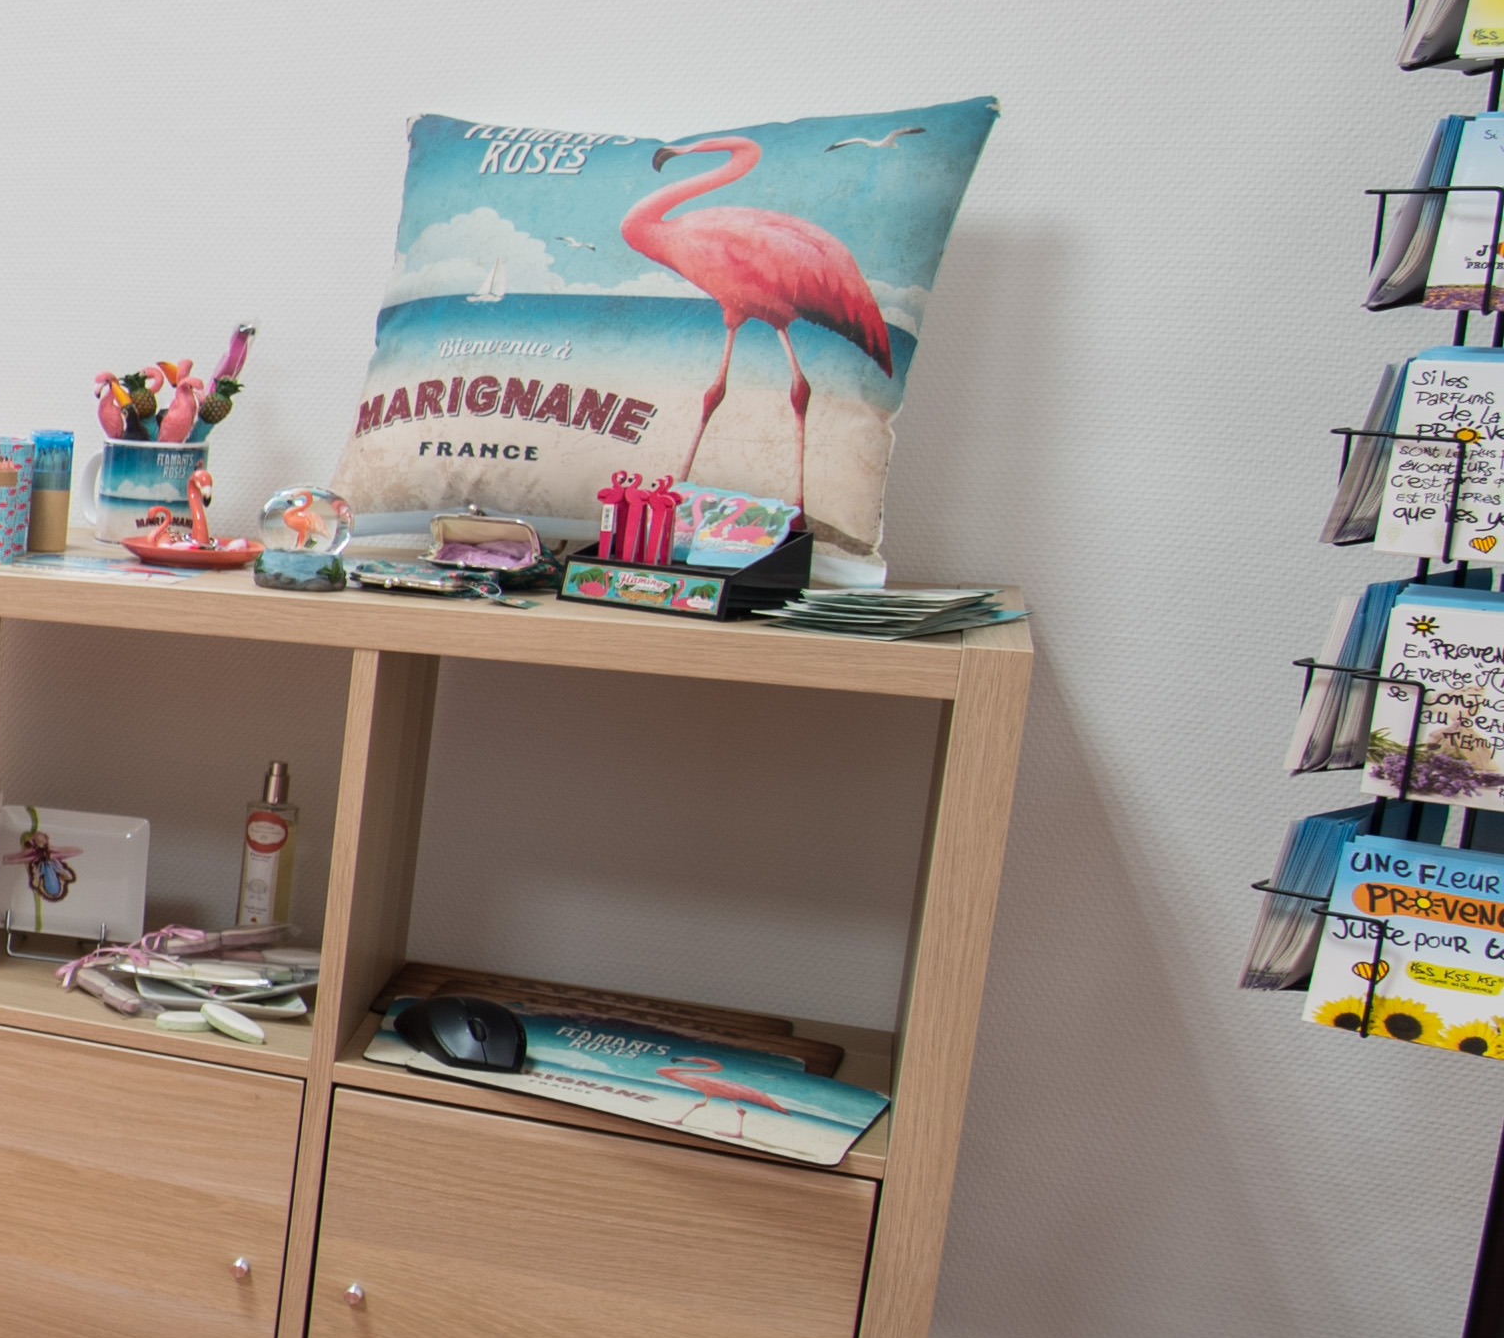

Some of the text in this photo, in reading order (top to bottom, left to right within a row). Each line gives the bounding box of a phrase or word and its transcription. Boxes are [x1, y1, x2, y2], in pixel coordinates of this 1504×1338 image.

[478, 140, 595, 176] ROSES
[438, 337, 573, 360] Bienvenue à
[1412, 370, 1469, 389] Si les
[355, 374, 658, 445] MARIGNANE
[1438, 404, 1472, 422] de
[419, 441, 539, 462] FRANCE
[1393, 507, 1436, 525] que
[556, 1025, 671, 1056] FLAMANTS
[569, 1039, 642, 1060] ROSES
[523, 1069, 659, 1104] RIGNANE
